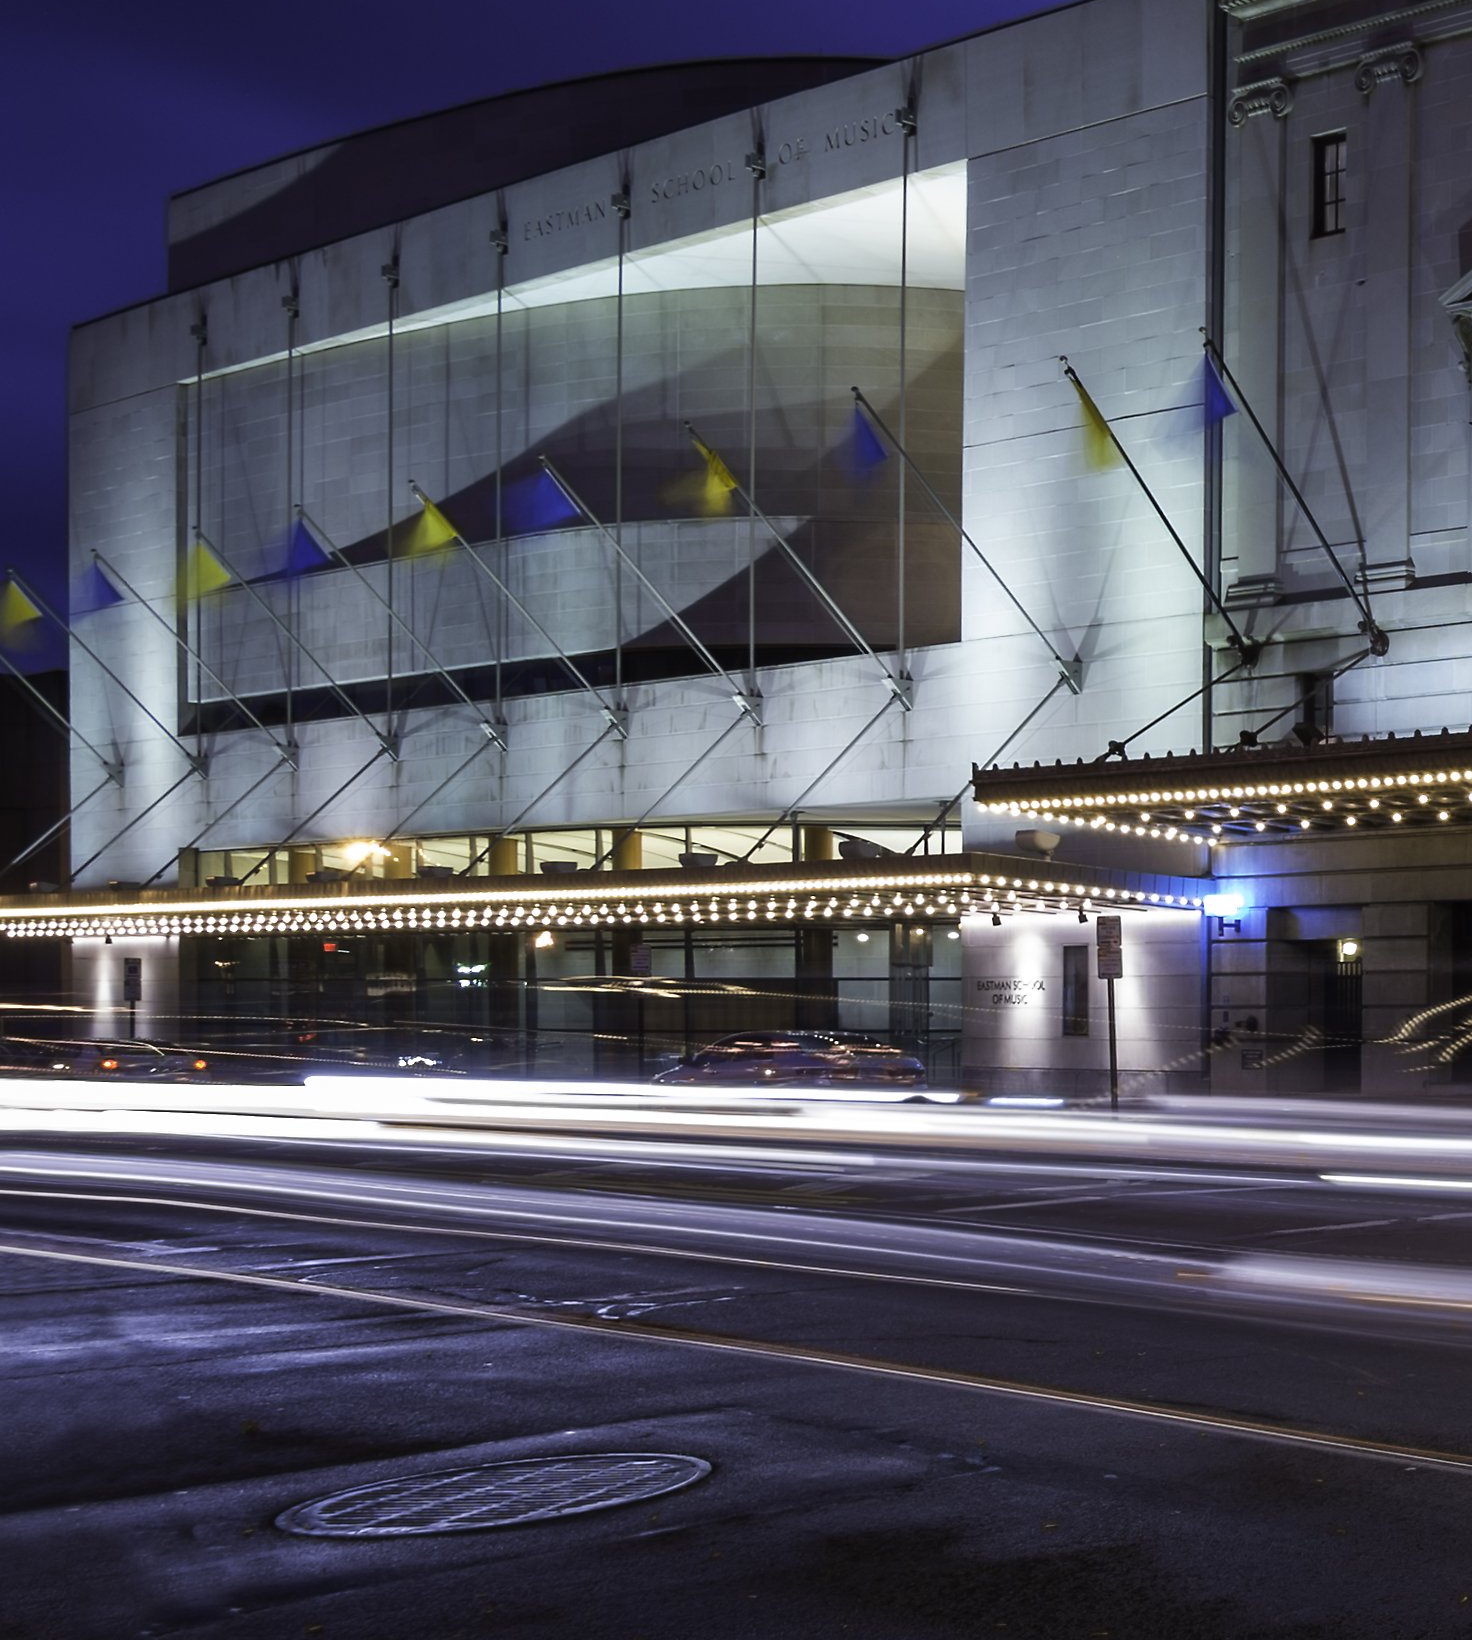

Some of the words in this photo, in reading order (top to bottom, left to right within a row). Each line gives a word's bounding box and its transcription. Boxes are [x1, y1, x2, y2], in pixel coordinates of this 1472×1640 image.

[523, 200, 608, 241] EASTMAN
[650, 159, 737, 205] SCHOOL
[778, 137, 809, 166] OF
[824, 112, 895, 153] MUSIC
[977, 980, 1012, 991] EASTMAN
[1013, 980, 1046, 991] SCOL
[992, 994, 1003, 1005] OF
[1004, 994, 1028, 1005] MUSC
